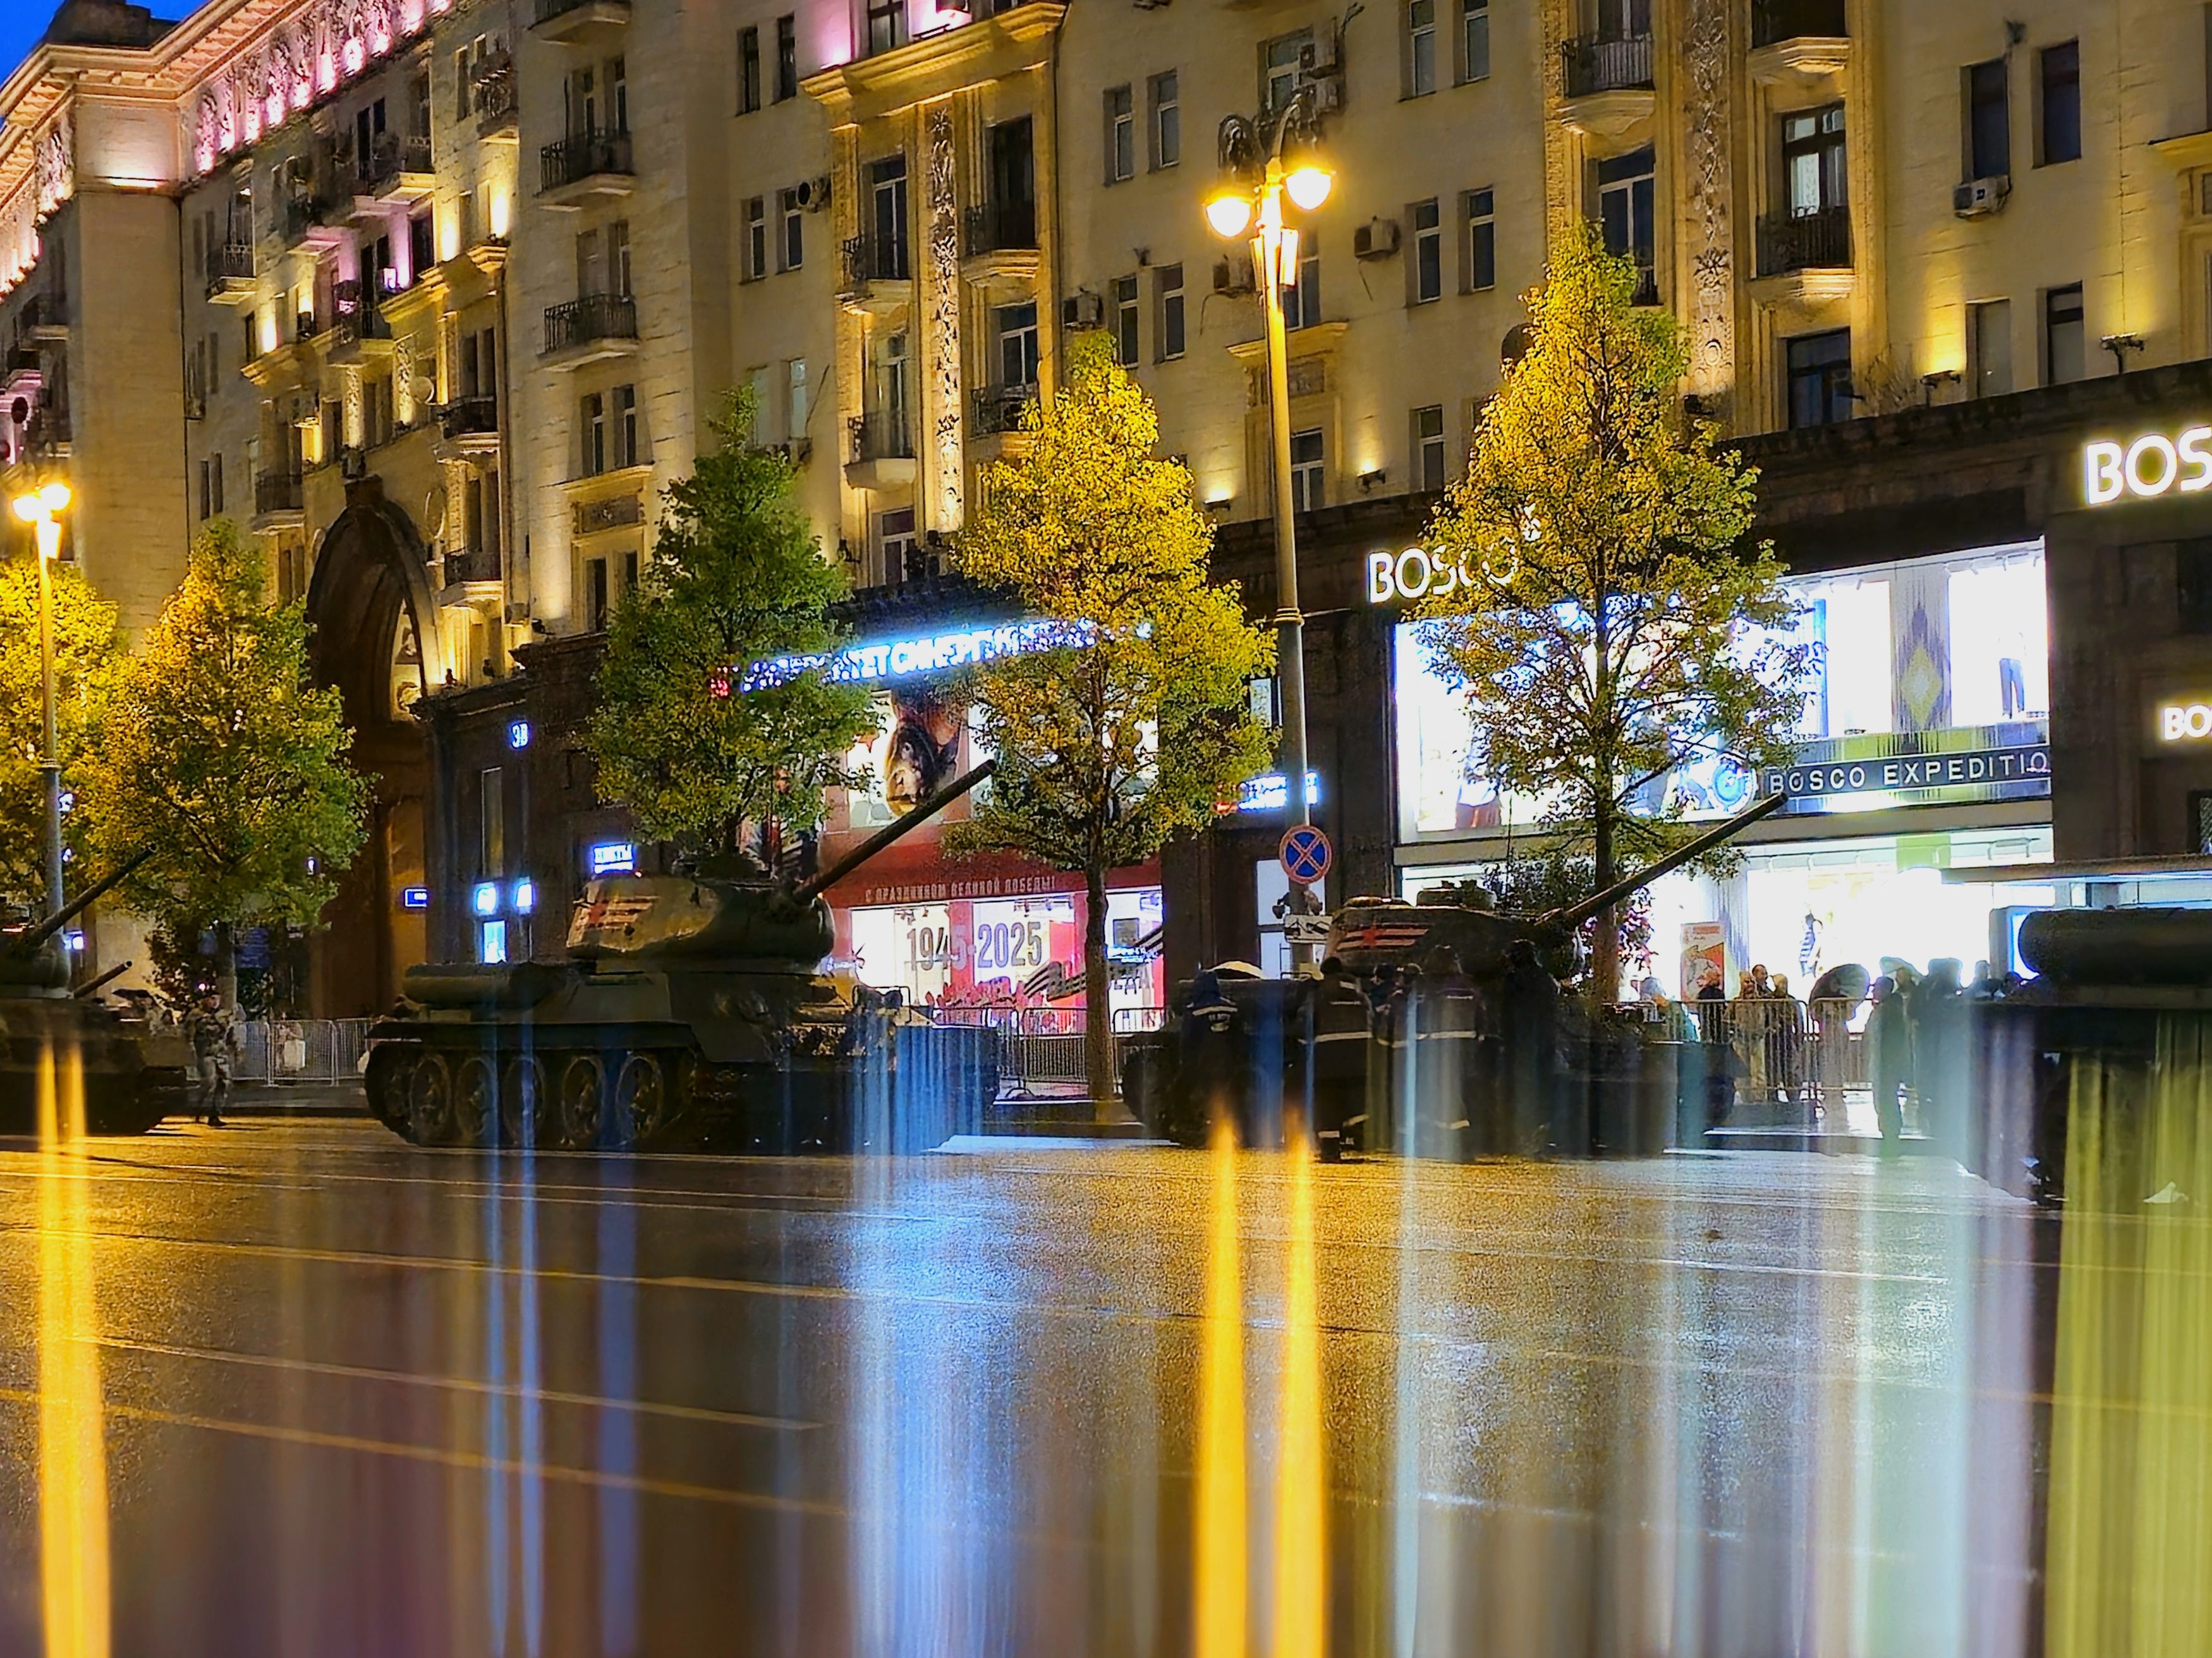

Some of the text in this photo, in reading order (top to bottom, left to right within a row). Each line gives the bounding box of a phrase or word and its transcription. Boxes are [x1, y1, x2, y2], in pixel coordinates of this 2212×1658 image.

[1770, 766, 1865, 794] BOSCO
[876, 884, 946, 902] ПРАЗДНИКОМ
[951, 877, 1000, 897] ВЕЛИКОЙ
[1005, 875, 1055, 893] ПОБЕДЫ!
